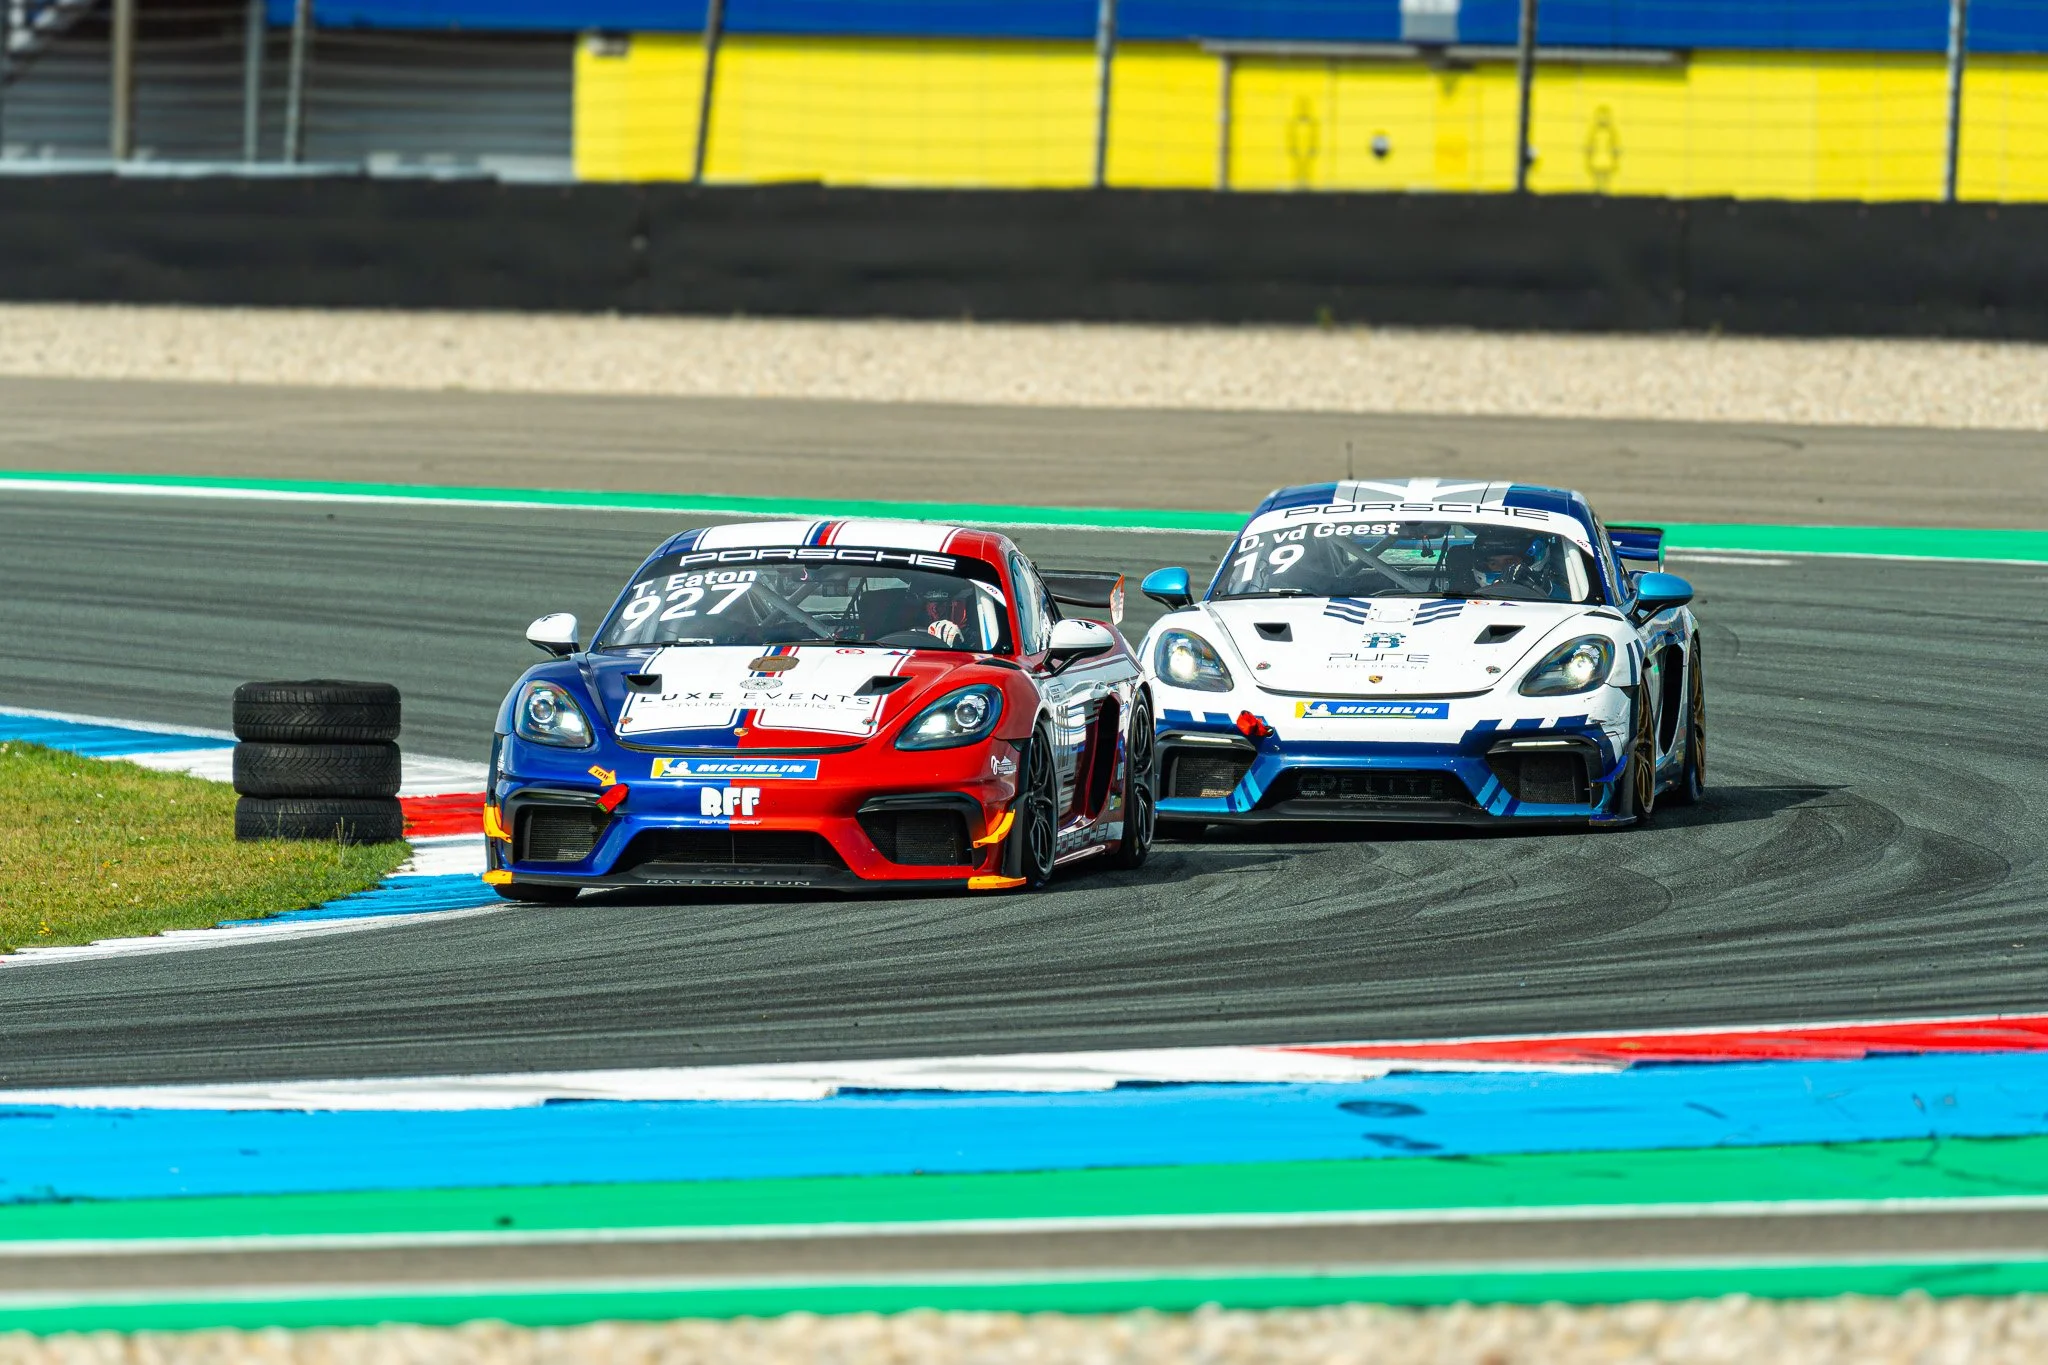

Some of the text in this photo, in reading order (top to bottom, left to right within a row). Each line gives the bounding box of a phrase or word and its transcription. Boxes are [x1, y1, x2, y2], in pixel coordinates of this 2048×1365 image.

[1284, 502, 1550, 521] PORSCHE
[1238, 522, 1401, 553] D. vd Geest
[679, 548, 957, 571] PORSCHE
[1233, 544, 1305, 583] 19
[632, 570, 758, 599] T. Eaton
[622, 582, 753, 632] 927
[1328, 653, 1430, 663] PURE
[640, 692, 871, 705] LUXE EVENTS
[754, 702, 836, 710] LOGISTICS
[1336, 706, 1439, 714] MICHELIN
[594, 769, 609, 781] TOW
[696, 763, 808, 773] MICHELIN
